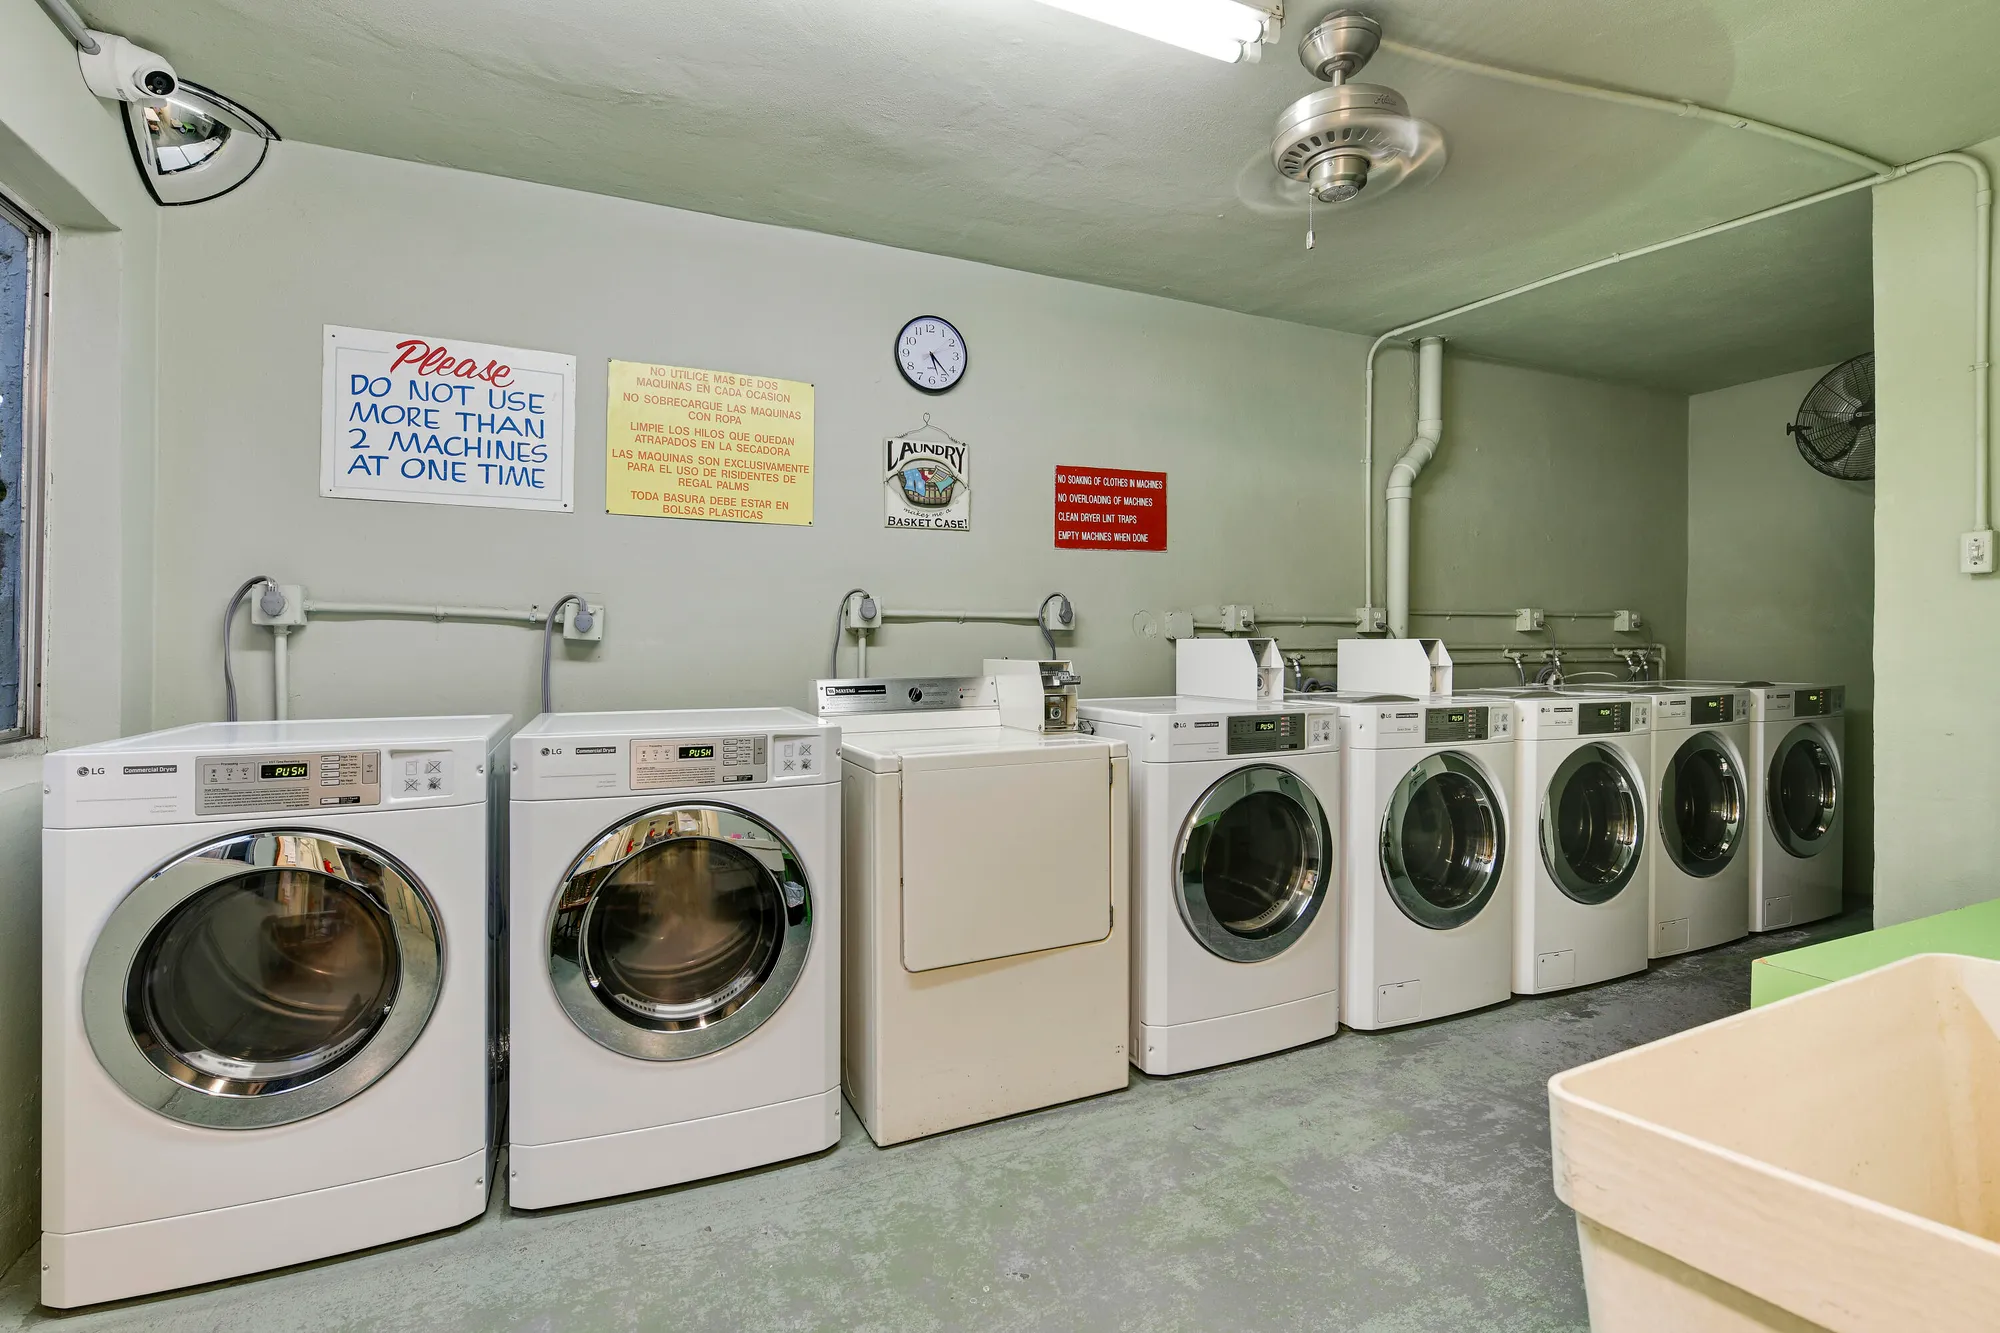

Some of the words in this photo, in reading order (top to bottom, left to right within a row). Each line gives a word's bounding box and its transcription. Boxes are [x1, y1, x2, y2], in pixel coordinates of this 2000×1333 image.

[915, 327, 922, 335] 11
[926, 325, 935, 333] 12
[906, 337, 916, 345] 10
[949, 339, 954, 347] 2
[903, 348, 909, 357] 9
[953, 352, 959, 361] 3
[390, 340, 514, 387] Please
[907, 362, 914, 370] 8
[650, 366, 665, 377] NO
[670, 369, 708, 382] UTILICE
[714, 375, 735, 385] MAS
[739, 378, 752, 387] DE
[757, 380, 778, 390] DOS
[917, 372, 923, 380] 7
[929, 376, 936, 384] 6
[940, 374, 947, 382] 5
[351, 374, 391, 397] DO
[409, 380, 475, 406] NOT
[488, 389, 545, 414] USE
[636, 377, 692, 391] MAQUINAS
[697, 384, 710, 394] EN
[715, 386, 742, 397] CADA
[746, 390, 790, 403] OCASION
[623, 392, 639, 402] NO
[644, 395, 723, 412] SOBRECARGUE
[727, 404, 746, 414] LAS
[750, 406, 801, 420] MAQUINAS
[349, 402, 440, 429] MORE
[455, 412, 544, 439] THAN
[688, 411, 710, 422] CON
[715, 414, 742, 425] ROPA
[630, 422, 664, 433] LIMPIE
[669, 426, 690, 436] LOS
[694, 428, 725, 439] HILOS
[729, 431, 750, 442] QUE
[754, 434, 795, 446] QUEDAN
[348, 428, 370, 449] 2
[388, 431, 548, 463] MACHINES
[634, 434, 696, 448] ATRAPADOS
[701, 441, 715, 450] EN
[719, 442, 732, 451] LA
[736, 444, 790, 456] SECADORA
[612, 449, 633, 459] LAS
[638, 451, 693, 464] MAQUINAS
[698, 456, 720, 466] SON
[724, 459, 810, 474] EXCLUSIVAMENTE
[888, 441, 965, 474] LAUNDRY
[347, 454, 389, 476] AT
[401, 458, 466, 482] ONE
[478, 464, 545, 489] TIME
[627, 462, 655, 473] PARA
[659, 465, 672, 474] EL
[676, 467, 698, 476] USO
[704, 469, 717, 478] DE
[721, 470, 779, 483] RISIDENTES
[783, 475, 796, 484] DE
[678, 478, 712, 488] REGAL
[717, 481, 750, 491] PALMS
[1058, 474, 1066, 483] NO
[1068, 475, 1092, 485] SOAKING
[1094, 477, 1101, 486] OF
[1104, 478, 1128, 487] CLOTHES
[1130, 479, 1135, 488] IN
[1137, 480, 1162, 489] MACHINES
[630, 490, 659, 501] TODA
[664, 493, 705, 504] BASURA
[710, 497, 737, 506] DEBE
[741, 499, 772, 508] ESTAR
[776, 501, 789, 510] EN
[1058, 493, 1067, 502] NO
[1070, 494, 1111, 505] OVERLOADING
[1114, 497, 1121, 505] OF
[1124, 497, 1152, 507] MACHINES
[663, 505, 705, 516] BOLSAS
[709, 508, 764, 520] PLASTICAS
[1058, 512, 1078, 521] CLEAN
[1081, 513, 1100, 522] DRYER
[1102, 514, 1115, 523] LINT
[1118, 515, 1137, 524] TRAPS
[888, 516, 931, 527] BASKET
[935, 518, 967, 529] CASE!
[1058, 531, 1079, 540] EMPTY
[1082, 532, 1111, 541] MACHINES
[1114, 533, 1130, 541] WHEN
[1133, 534, 1148, 542] DONE
[689, 748, 711, 756] PUSH
[276, 767, 305, 776] PUSH
